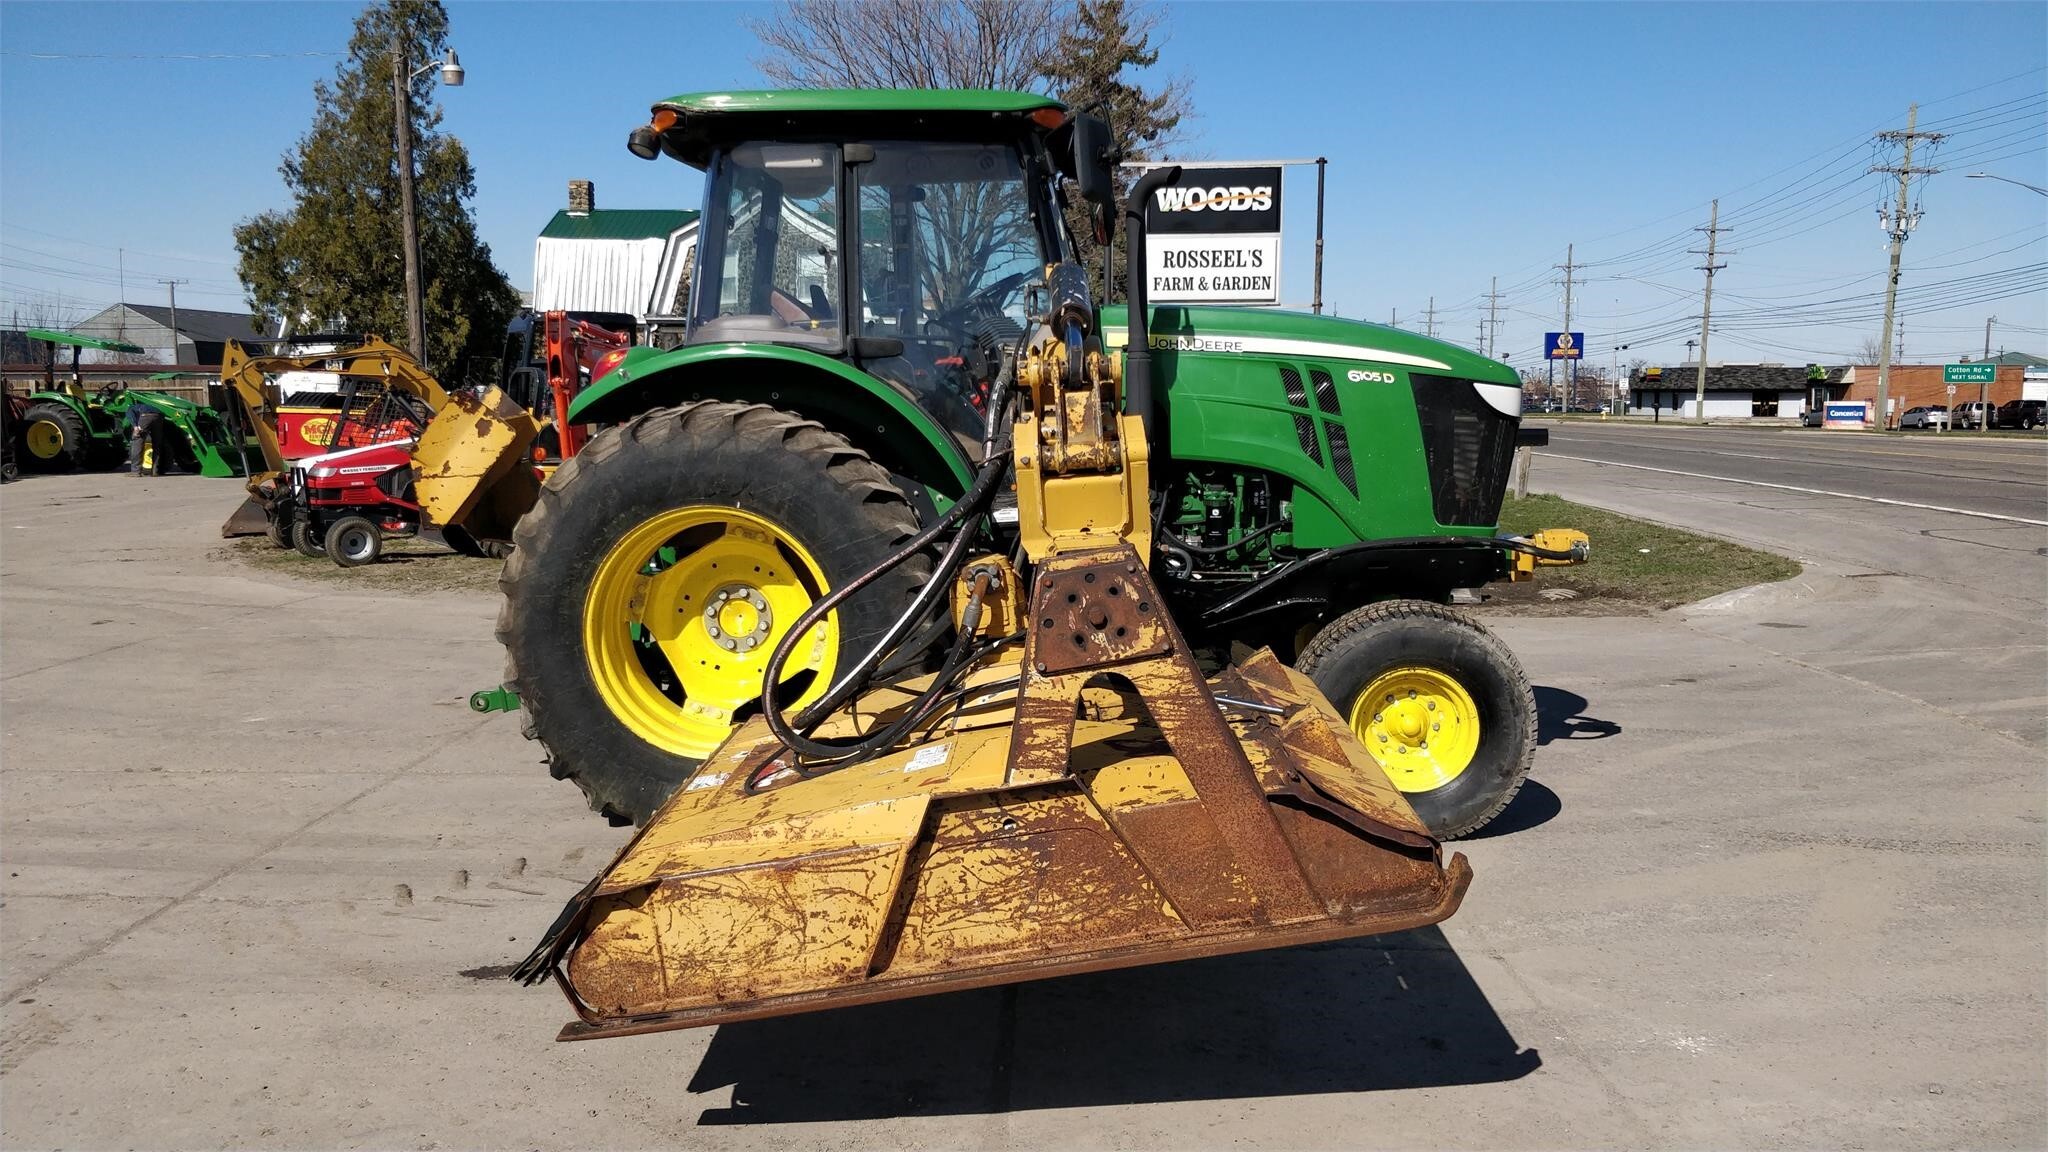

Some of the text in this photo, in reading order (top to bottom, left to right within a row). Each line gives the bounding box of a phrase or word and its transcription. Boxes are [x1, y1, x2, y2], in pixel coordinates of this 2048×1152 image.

[1155, 186, 1273, 212] WOODS
[1163, 249, 1263, 269] ROSSEEL'S
[1153, 275, 1272, 292] FARM & GARDEN
[1149, 336, 1243, 350] JOHN DEERE
[325, 359, 345, 371] CAT
